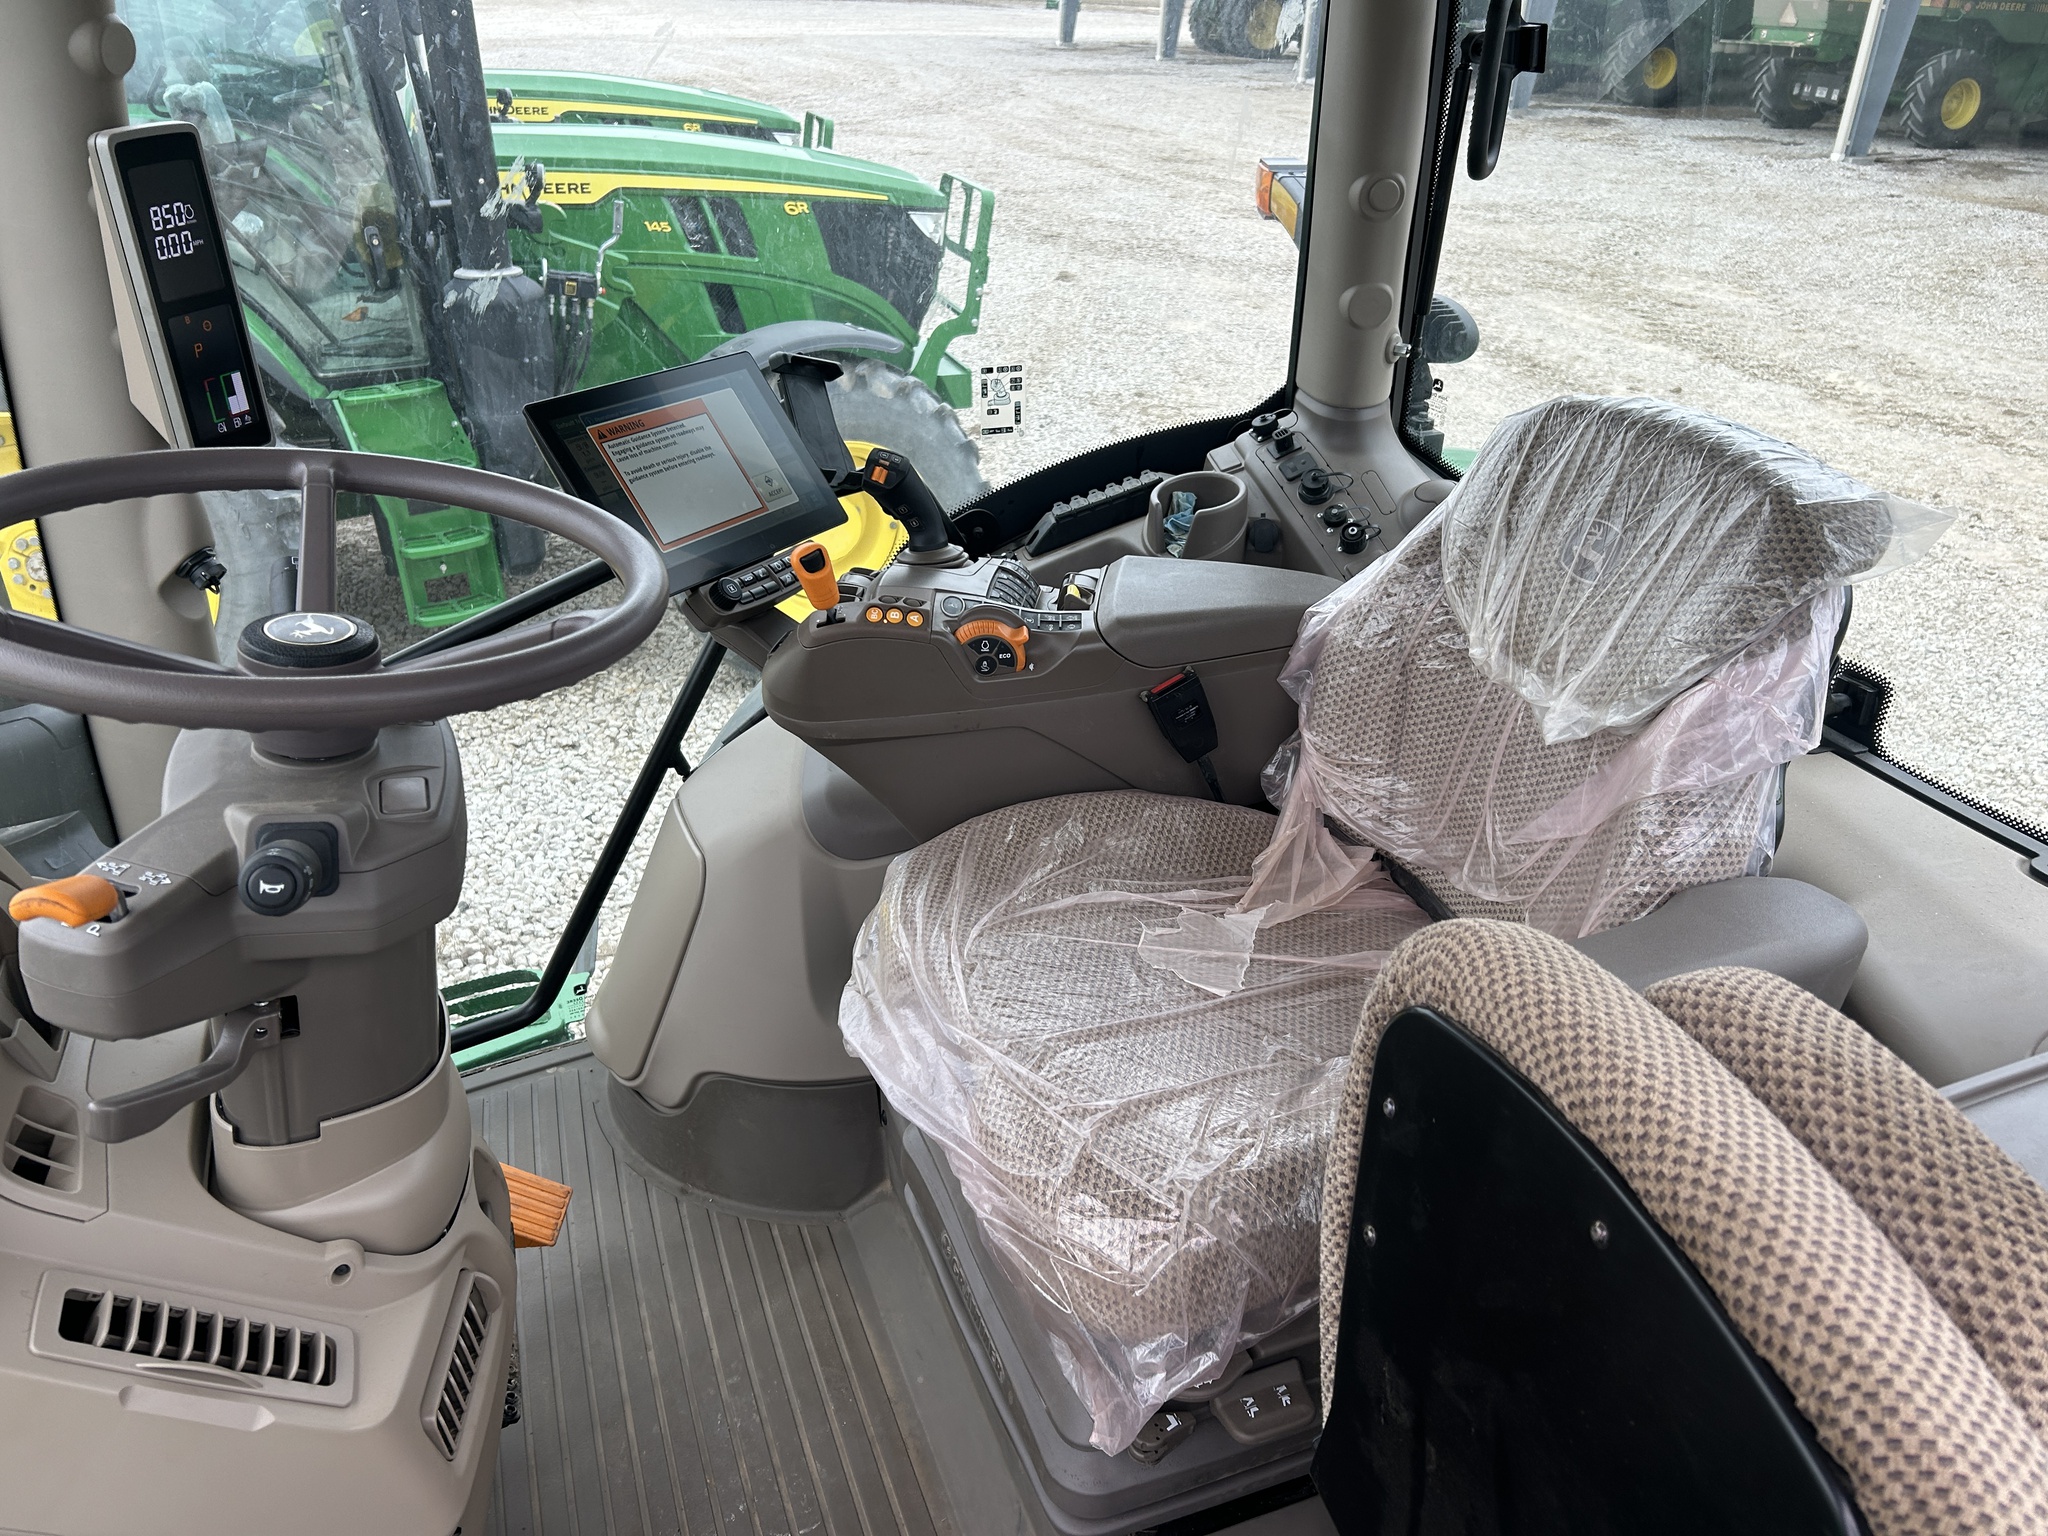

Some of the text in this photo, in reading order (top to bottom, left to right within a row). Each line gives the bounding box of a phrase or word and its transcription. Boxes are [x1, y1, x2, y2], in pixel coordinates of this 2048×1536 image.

[1976, 1, 2027, 11] JOHN DEERE
[683, 123, 701, 132] 6R
[543, 182, 592, 195] EERE
[784, 201, 810, 216] 6R
[149, 202, 186, 231] 850
[644, 220, 672, 233] 145
[155, 230, 194, 260] 0.00
[606, 420, 645, 436] WARNING
[607, 422, 686, 449] Automatic Guidance System Detected.
[611, 445, 633, 456] Engaging
[636, 440, 655, 451] guidance
[655, 435, 670, 444] system
[676, 428, 695, 437] roadways
[616, 455, 629, 463] cause
[644, 446, 662, 454] machine
[631, 466, 643, 475] avoid
[642, 462, 656, 471] death
[660, 456, 676, 465] serious
[690, 448, 705, 456] disable
[629, 473, 649, 484] guidance
[648, 468, 664, 477] system
[663, 464, 678, 472] before
[677, 458, 696, 467] entering
[768, 487, 784, 497] ACCEPT
[890, 611, 900, 619] B
[910, 615, 919, 623] A
[86, 924, 101, 937] P
